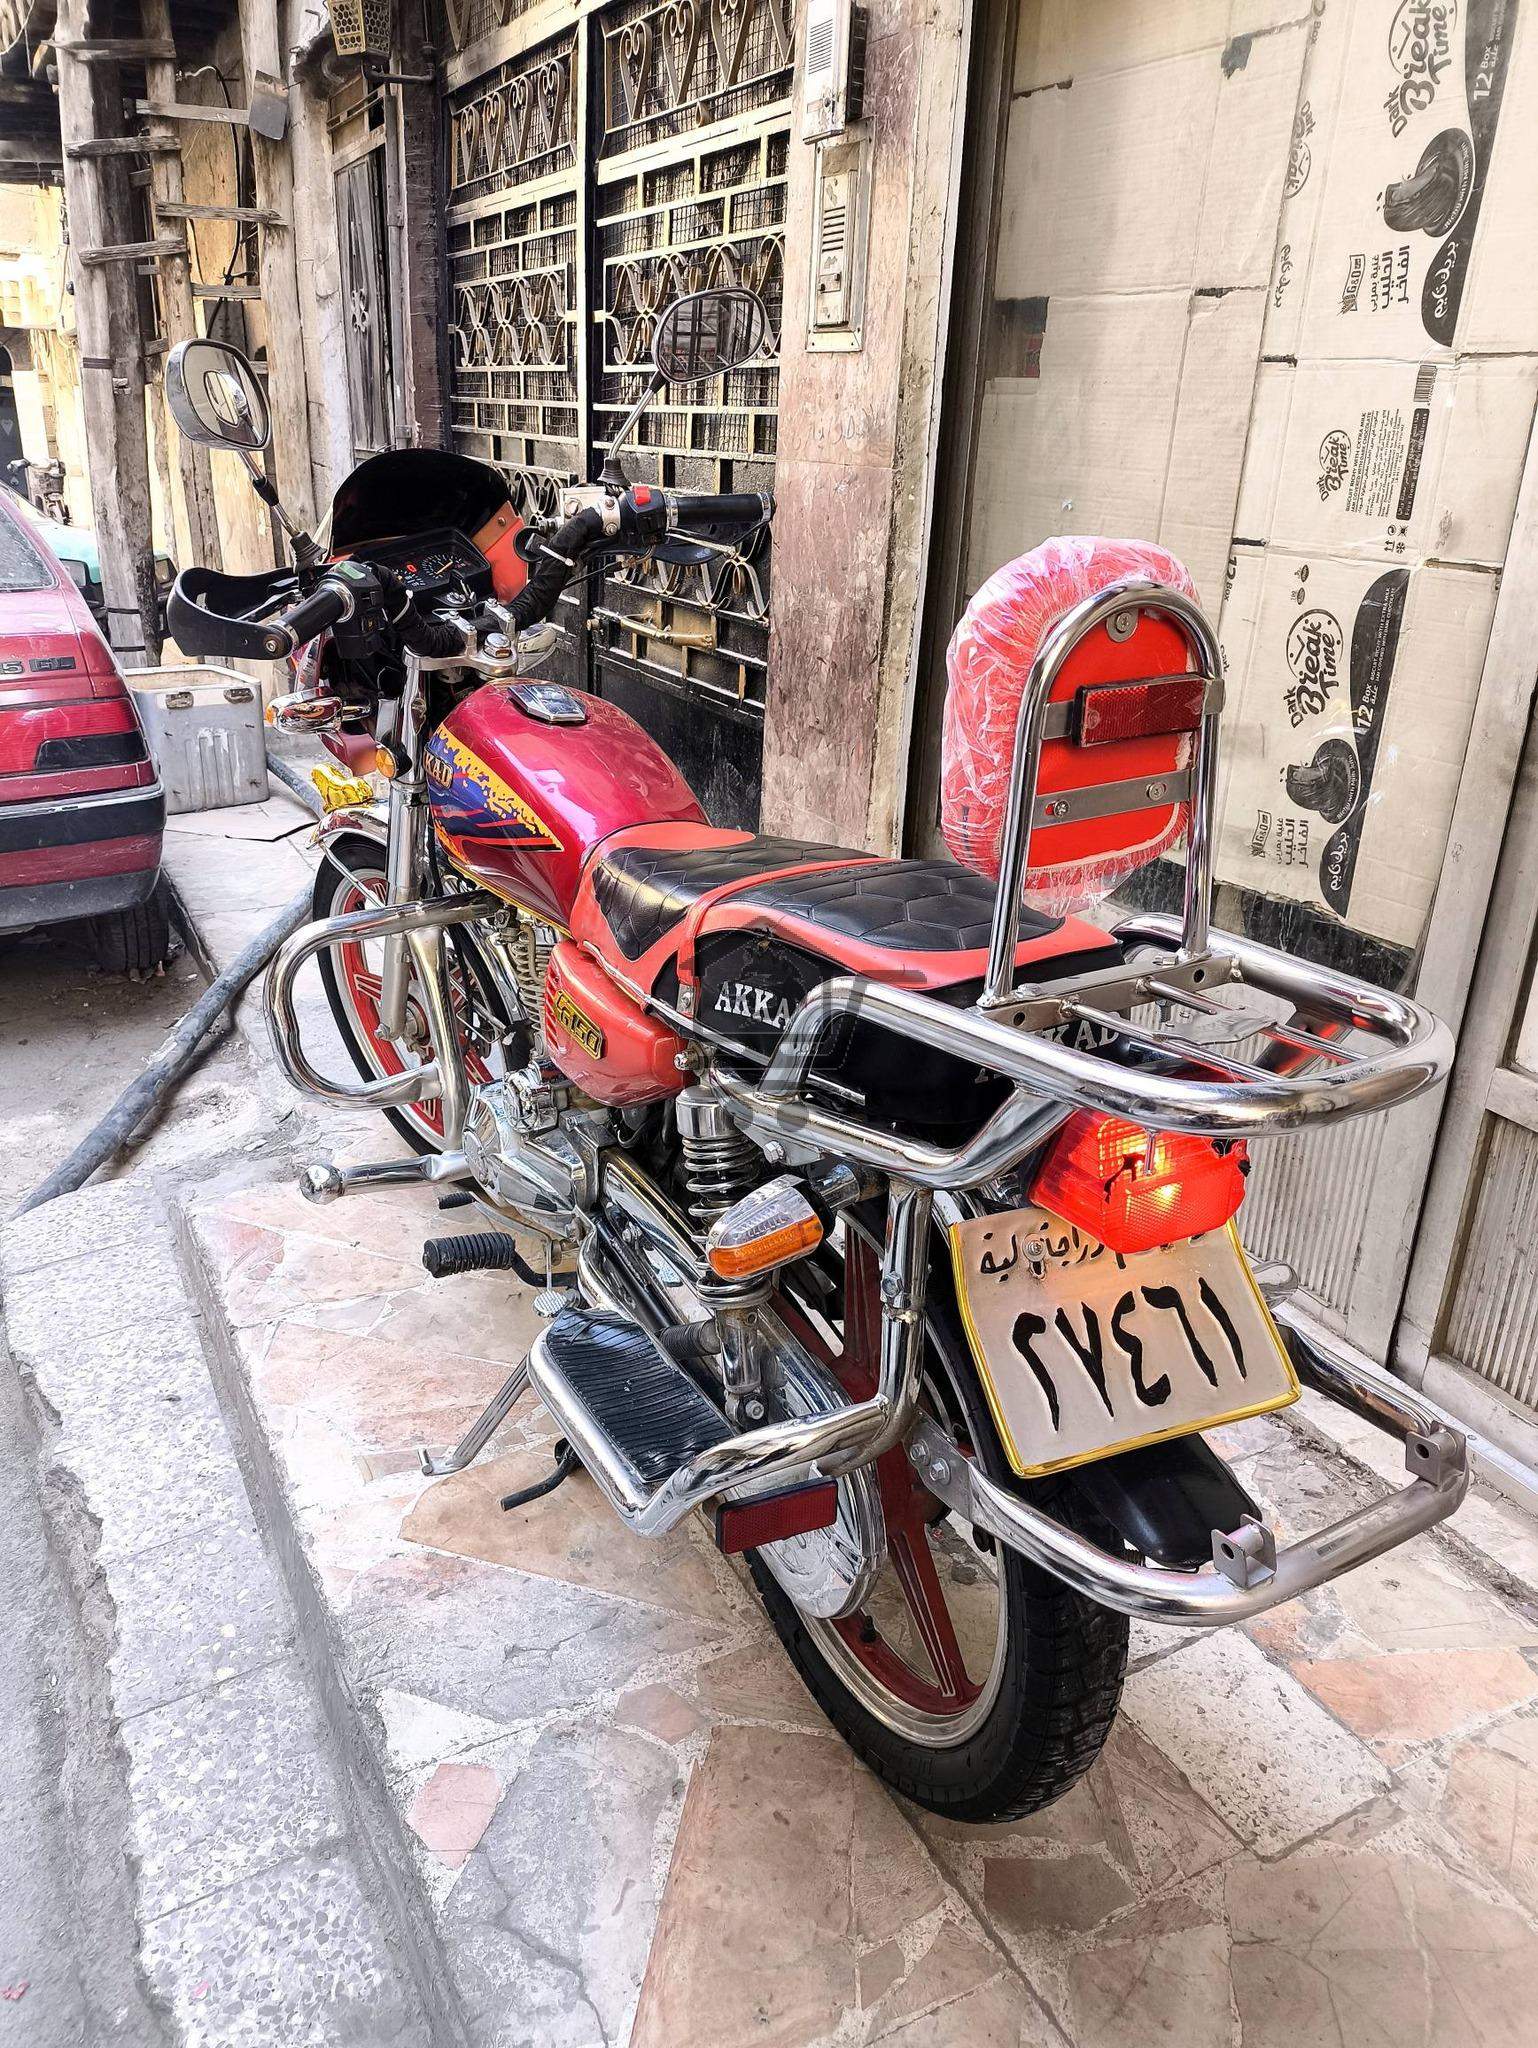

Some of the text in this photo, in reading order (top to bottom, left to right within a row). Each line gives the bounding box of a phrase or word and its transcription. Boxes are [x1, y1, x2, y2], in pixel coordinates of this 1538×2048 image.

[1408, 0, 1434, 115] Break
[1432, 4, 1452, 85] Time
[1473, 46, 1494, 102] 12 Box
[1301, 100, 1316, 137] Dark
[1383, 85, 1408, 138] Dark
[1380, 251, 1393, 309] الحليب
[1398, 245, 1409, 304] الفاخر
[1326, 437, 1341, 491] Break
[1339, 443, 1349, 480] Time
[1316, 474, 1329, 501] Dark
[1224, 582, 1233, 602] Box
[1298, 622, 1325, 714] Break
[1323, 634, 1339, 699] Time
[1284, 686, 1303, 728] Dark
[1355, 683, 1375, 729] 12 Box
[1286, 819, 1295, 865] الحليب
[1299, 820, 1309, 868] الفاخر
[714, 980, 791, 1031] AKKA
[1035, 1019, 1120, 1051] KAD
